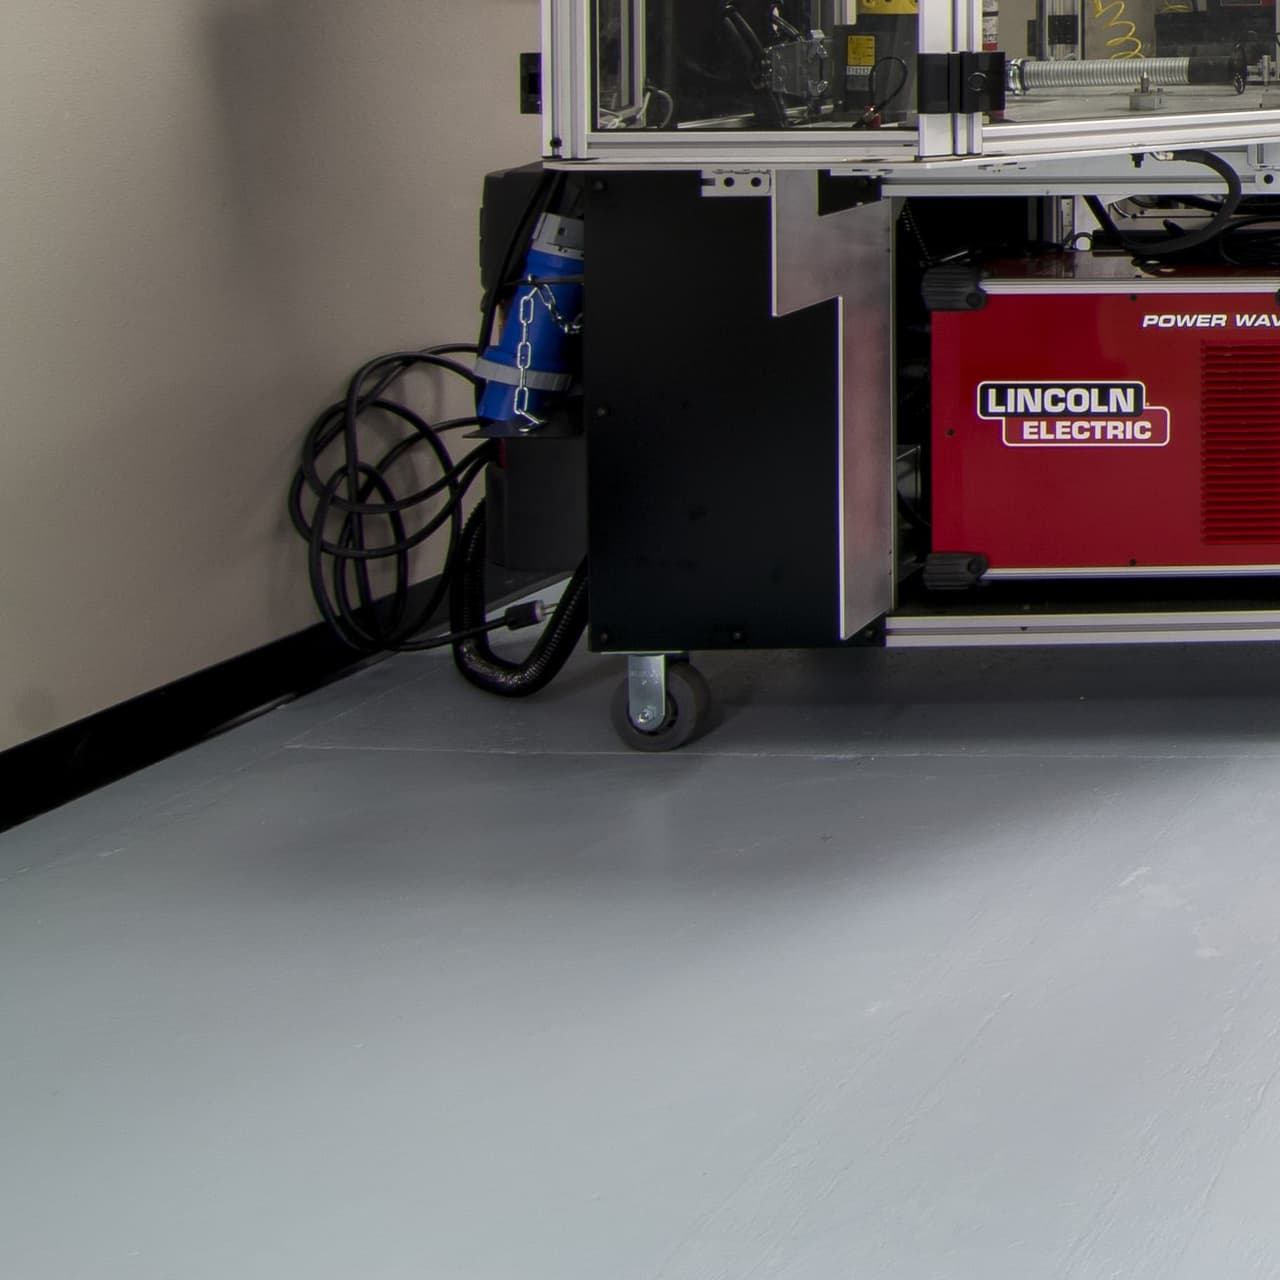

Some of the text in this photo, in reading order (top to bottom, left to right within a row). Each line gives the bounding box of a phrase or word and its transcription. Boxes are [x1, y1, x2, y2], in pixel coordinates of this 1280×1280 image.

[1142, 314, 1228, 328] POWER
[987, 387, 1135, 413] LINCOLN
[1022, 420, 1153, 440] ELECTRIC
